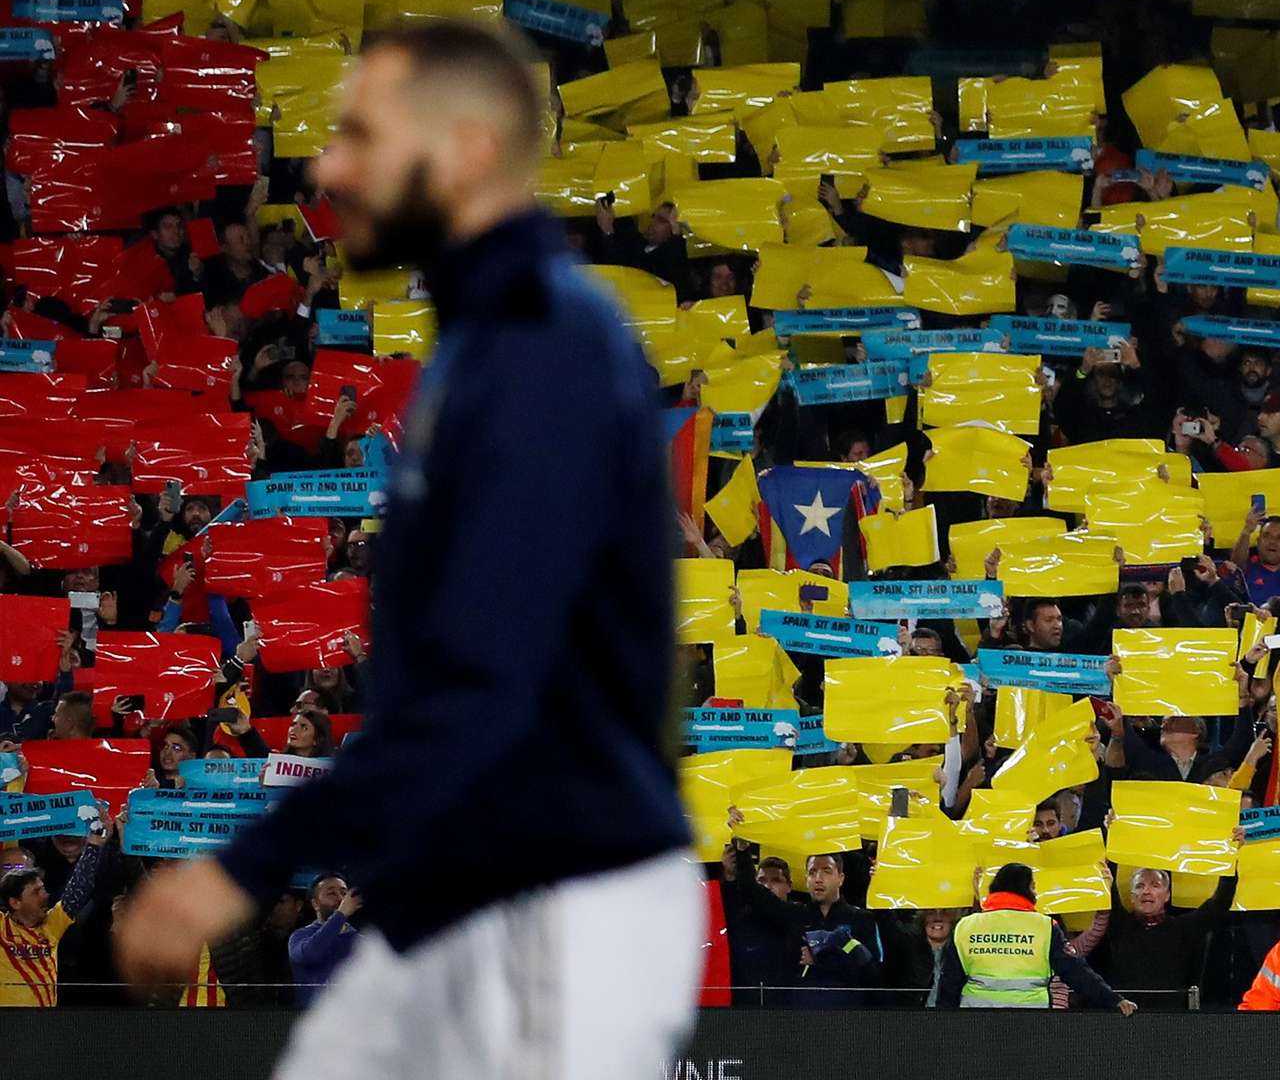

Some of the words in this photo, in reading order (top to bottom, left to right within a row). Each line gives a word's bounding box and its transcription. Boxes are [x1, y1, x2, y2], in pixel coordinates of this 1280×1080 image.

[266, 482, 296, 494] SPAIN,
[300, 482, 313, 493] SIT
[318, 482, 338, 491] AND
[342, 481, 367, 492] TALK!
[873, 586, 904, 595] SPAIN,
[782, 616, 812, 628] SPAIN,
[815, 619, 828, 629] SIT
[831, 622, 851, 632] AND
[854, 624, 879, 635] TALK!
[701, 713, 717, 721] SIT
[720, 713, 740, 721] AND
[743, 712, 772, 721] TALK!
[799, 721, 823, 730] TALK
[204, 762, 236, 774] SPAIN,
[241, 763, 255, 773] SIT
[212, 791, 233, 800] AND
[239, 791, 266, 800] TALK!
[11, 802, 23, 814] SIT
[27, 800, 45, 811] AND
[49, 797, 74, 809] TALK!
[1240, 810, 1260, 821] AND
[150, 820, 183, 832] SPAIN,
[189, 821, 203, 833] SIT
[209, 823, 229, 834] AND
[969, 934, 1034, 944] SEGURETAT
